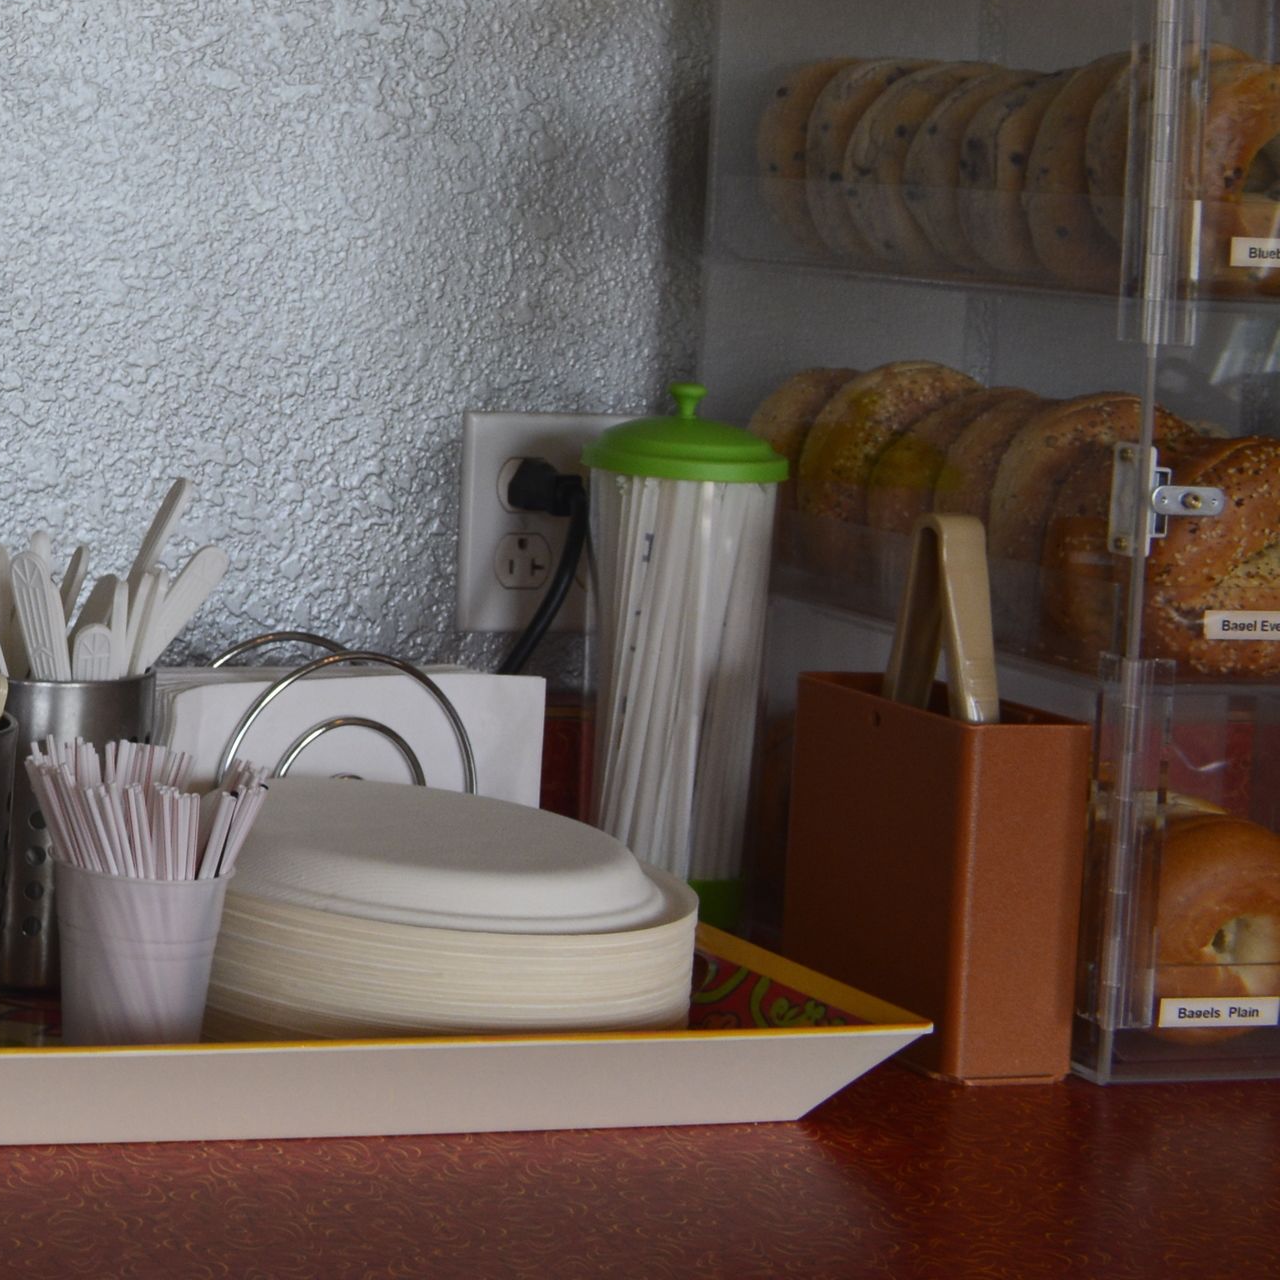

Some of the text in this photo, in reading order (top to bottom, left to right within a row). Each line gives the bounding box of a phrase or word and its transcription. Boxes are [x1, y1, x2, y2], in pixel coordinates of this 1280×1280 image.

[1221, 619, 1257, 632] Bagel
[1178, 1006, 1260, 1020] Bagels Plain
